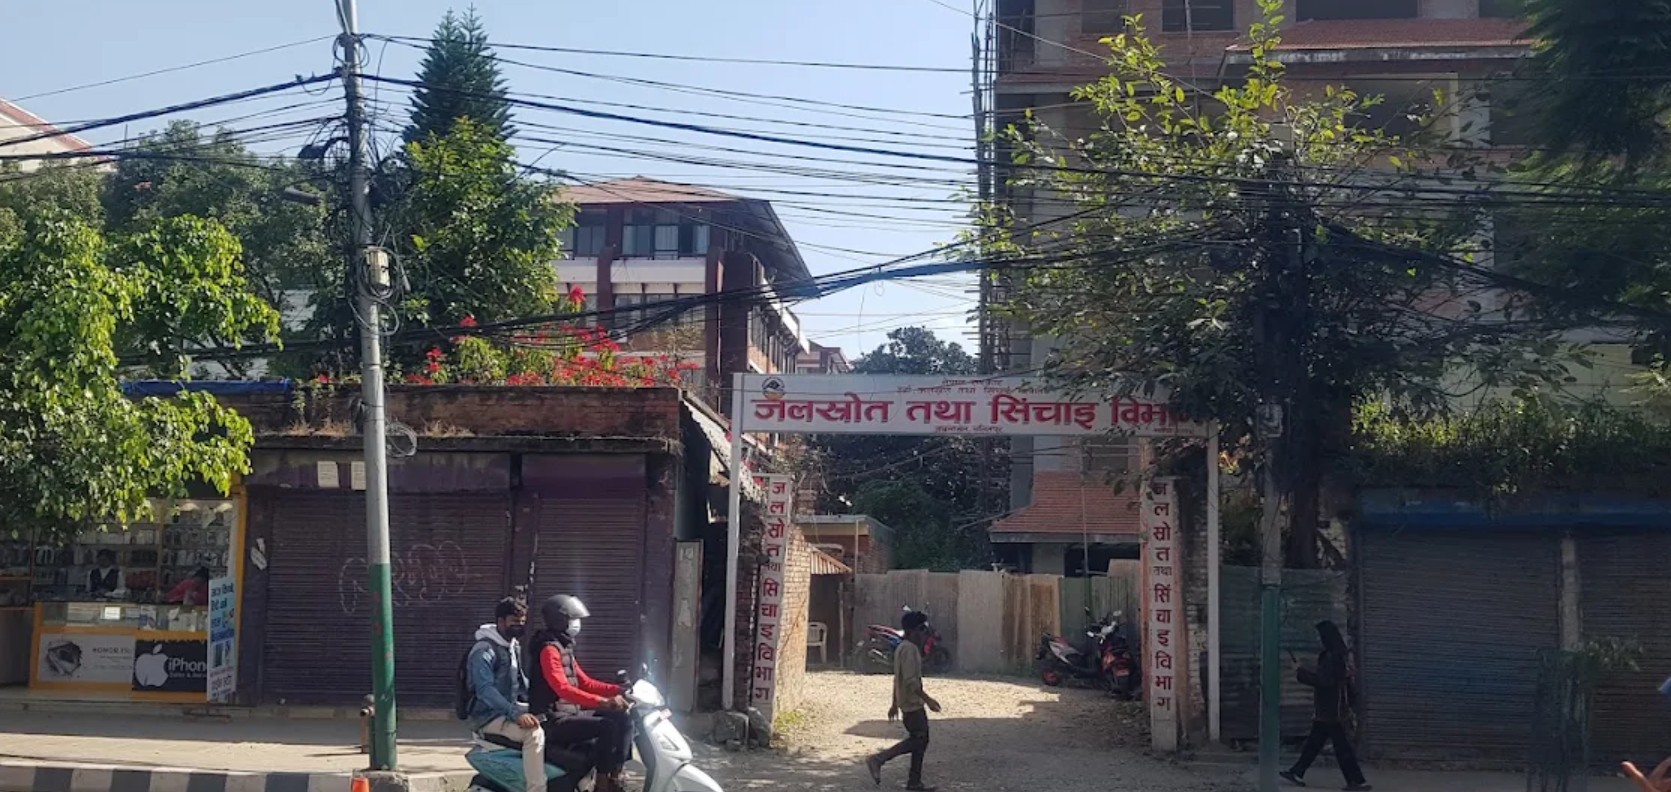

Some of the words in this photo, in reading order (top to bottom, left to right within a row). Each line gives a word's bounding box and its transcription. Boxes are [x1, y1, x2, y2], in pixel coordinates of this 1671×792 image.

[751, 392, 893, 423] जलस्रोत
[906, 400, 976, 424] तथा
[989, 393, 1099, 429] सिंचाइ
[168, 657, 207, 671] iPhon
[755, 642, 775, 700] विभाग
[1154, 650, 1173, 711] विभाग
